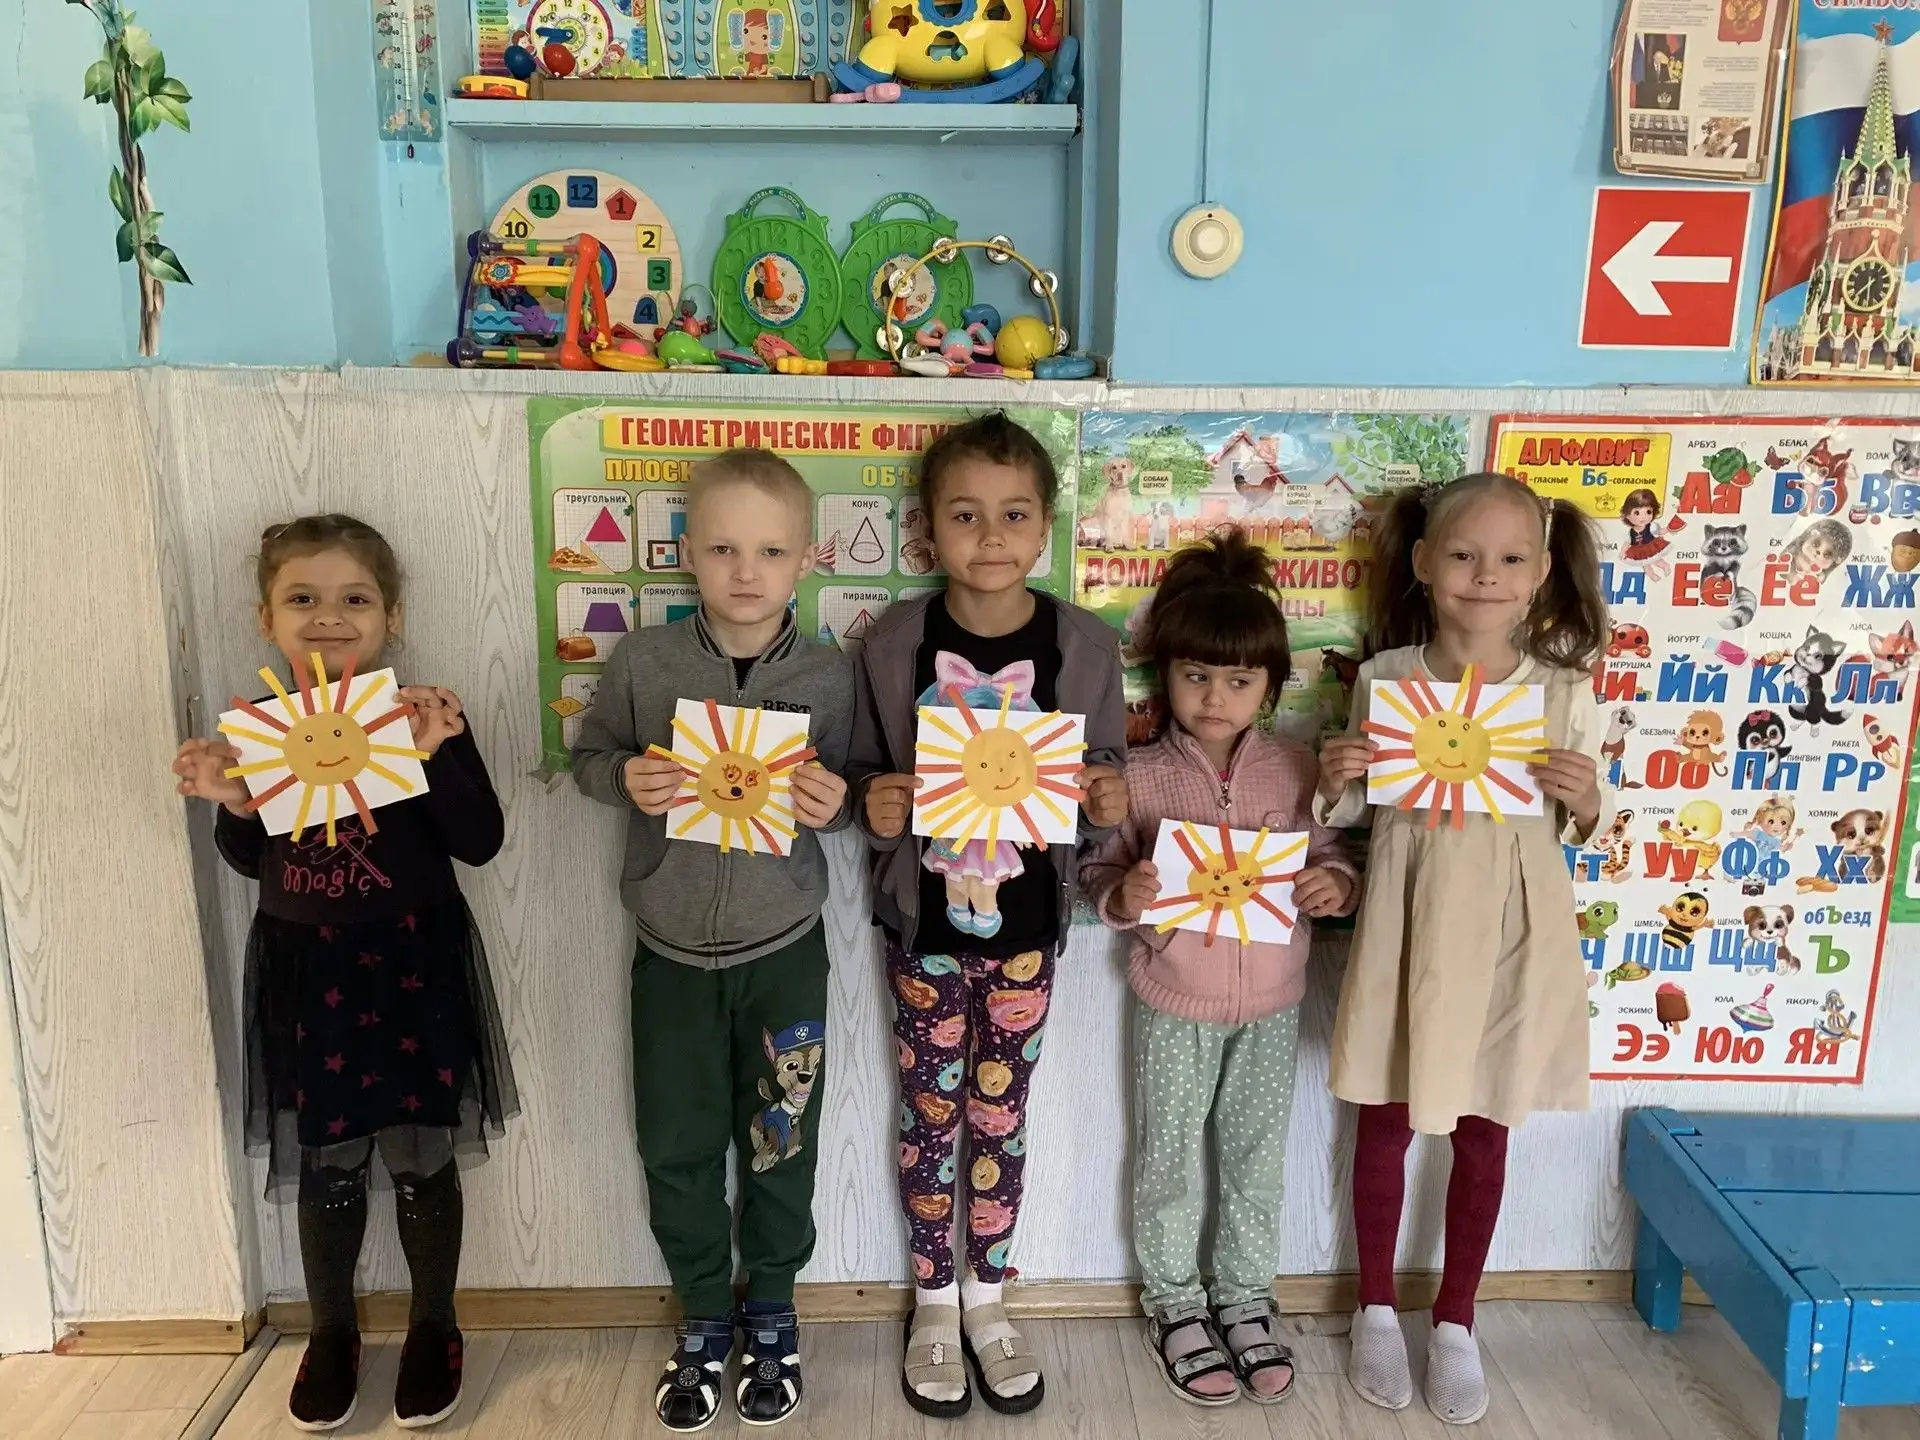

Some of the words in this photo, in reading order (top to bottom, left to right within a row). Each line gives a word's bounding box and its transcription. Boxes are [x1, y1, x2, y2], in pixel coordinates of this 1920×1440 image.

[540, 15, 548, 23] 10
[592, 16, 598, 24] 2
[597, 32, 603, 40] 3
[531, 193, 556, 211] 11
[570, 184, 595, 201] 12
[615, 197, 627, 214] 1
[504, 221, 528, 238] 10
[642, 231, 656, 248] 2
[652, 266, 666, 283] 3
[639, 308, 653, 322] 4
[621, 417, 861, 450] ГЕОМЕТРИЧЕСКИЕ
[872, 423, 953, 451] ФИГУ
[1778, 438, 1808, 447] БЕЛКА
[1518, 437, 1650, 466] АЛФАВИТ
[1688, 440, 1717, 449] АРБУЗ
[1865, 452, 1890, 460] ВОЛК
[605, 458, 695, 483] ПЛОСК
[862, 464, 919, 488] ОБЪ
[566, 494, 628, 505] треугольник
[666, 497, 688, 506] квад
[1677, 472, 1744, 514] Аа
[1771, 472, 1839, 516] Бб
[851, 499, 879, 509] конус
[1084, 557, 1169, 592] ДОМА
[581, 586, 626, 596] трапеция
[645, 587, 701, 597] прямоугольн
[1671, 563, 1734, 607] Ее
[1841, 565, 1920, 608] Жж
[842, 592, 888, 602] пирамида
[1278, 600, 1325, 620] ЦЫ
[1849, 623, 1873, 631] ЛИСА
[1667, 635, 1700, 643] ЙОГУРТ
[1656, 654, 1728, 702] Йй
[1831, 664, 1898, 704] Лл
[1645, 750, 1710, 789] Оо
[1731, 751, 1801, 790] Пп
[1822, 752, 1886, 792] Рр
[1642, 806, 1675, 815] УТЁНОК
[1731, 808, 1748, 816] ФЕЯ
[1643, 842, 1699, 882] Уу
[1722, 838, 1790, 886] Фф
[1815, 845, 1871, 885] Хх
[283, 860, 371, 897] Magic
[1634, 920, 1664, 928] ШМЕЛЬ
[1717, 918, 1743, 926] ЩЕНОК
[1623, 933, 1695, 971] Шш
[1709, 929, 1777, 972] Щщ
[1808, 935, 1850, 974] Ъ
[1612, 1023, 1670, 1062] Ээ
[1694, 1027, 1764, 1064] Юю
[1784, 1028, 1840, 1065] Яя
